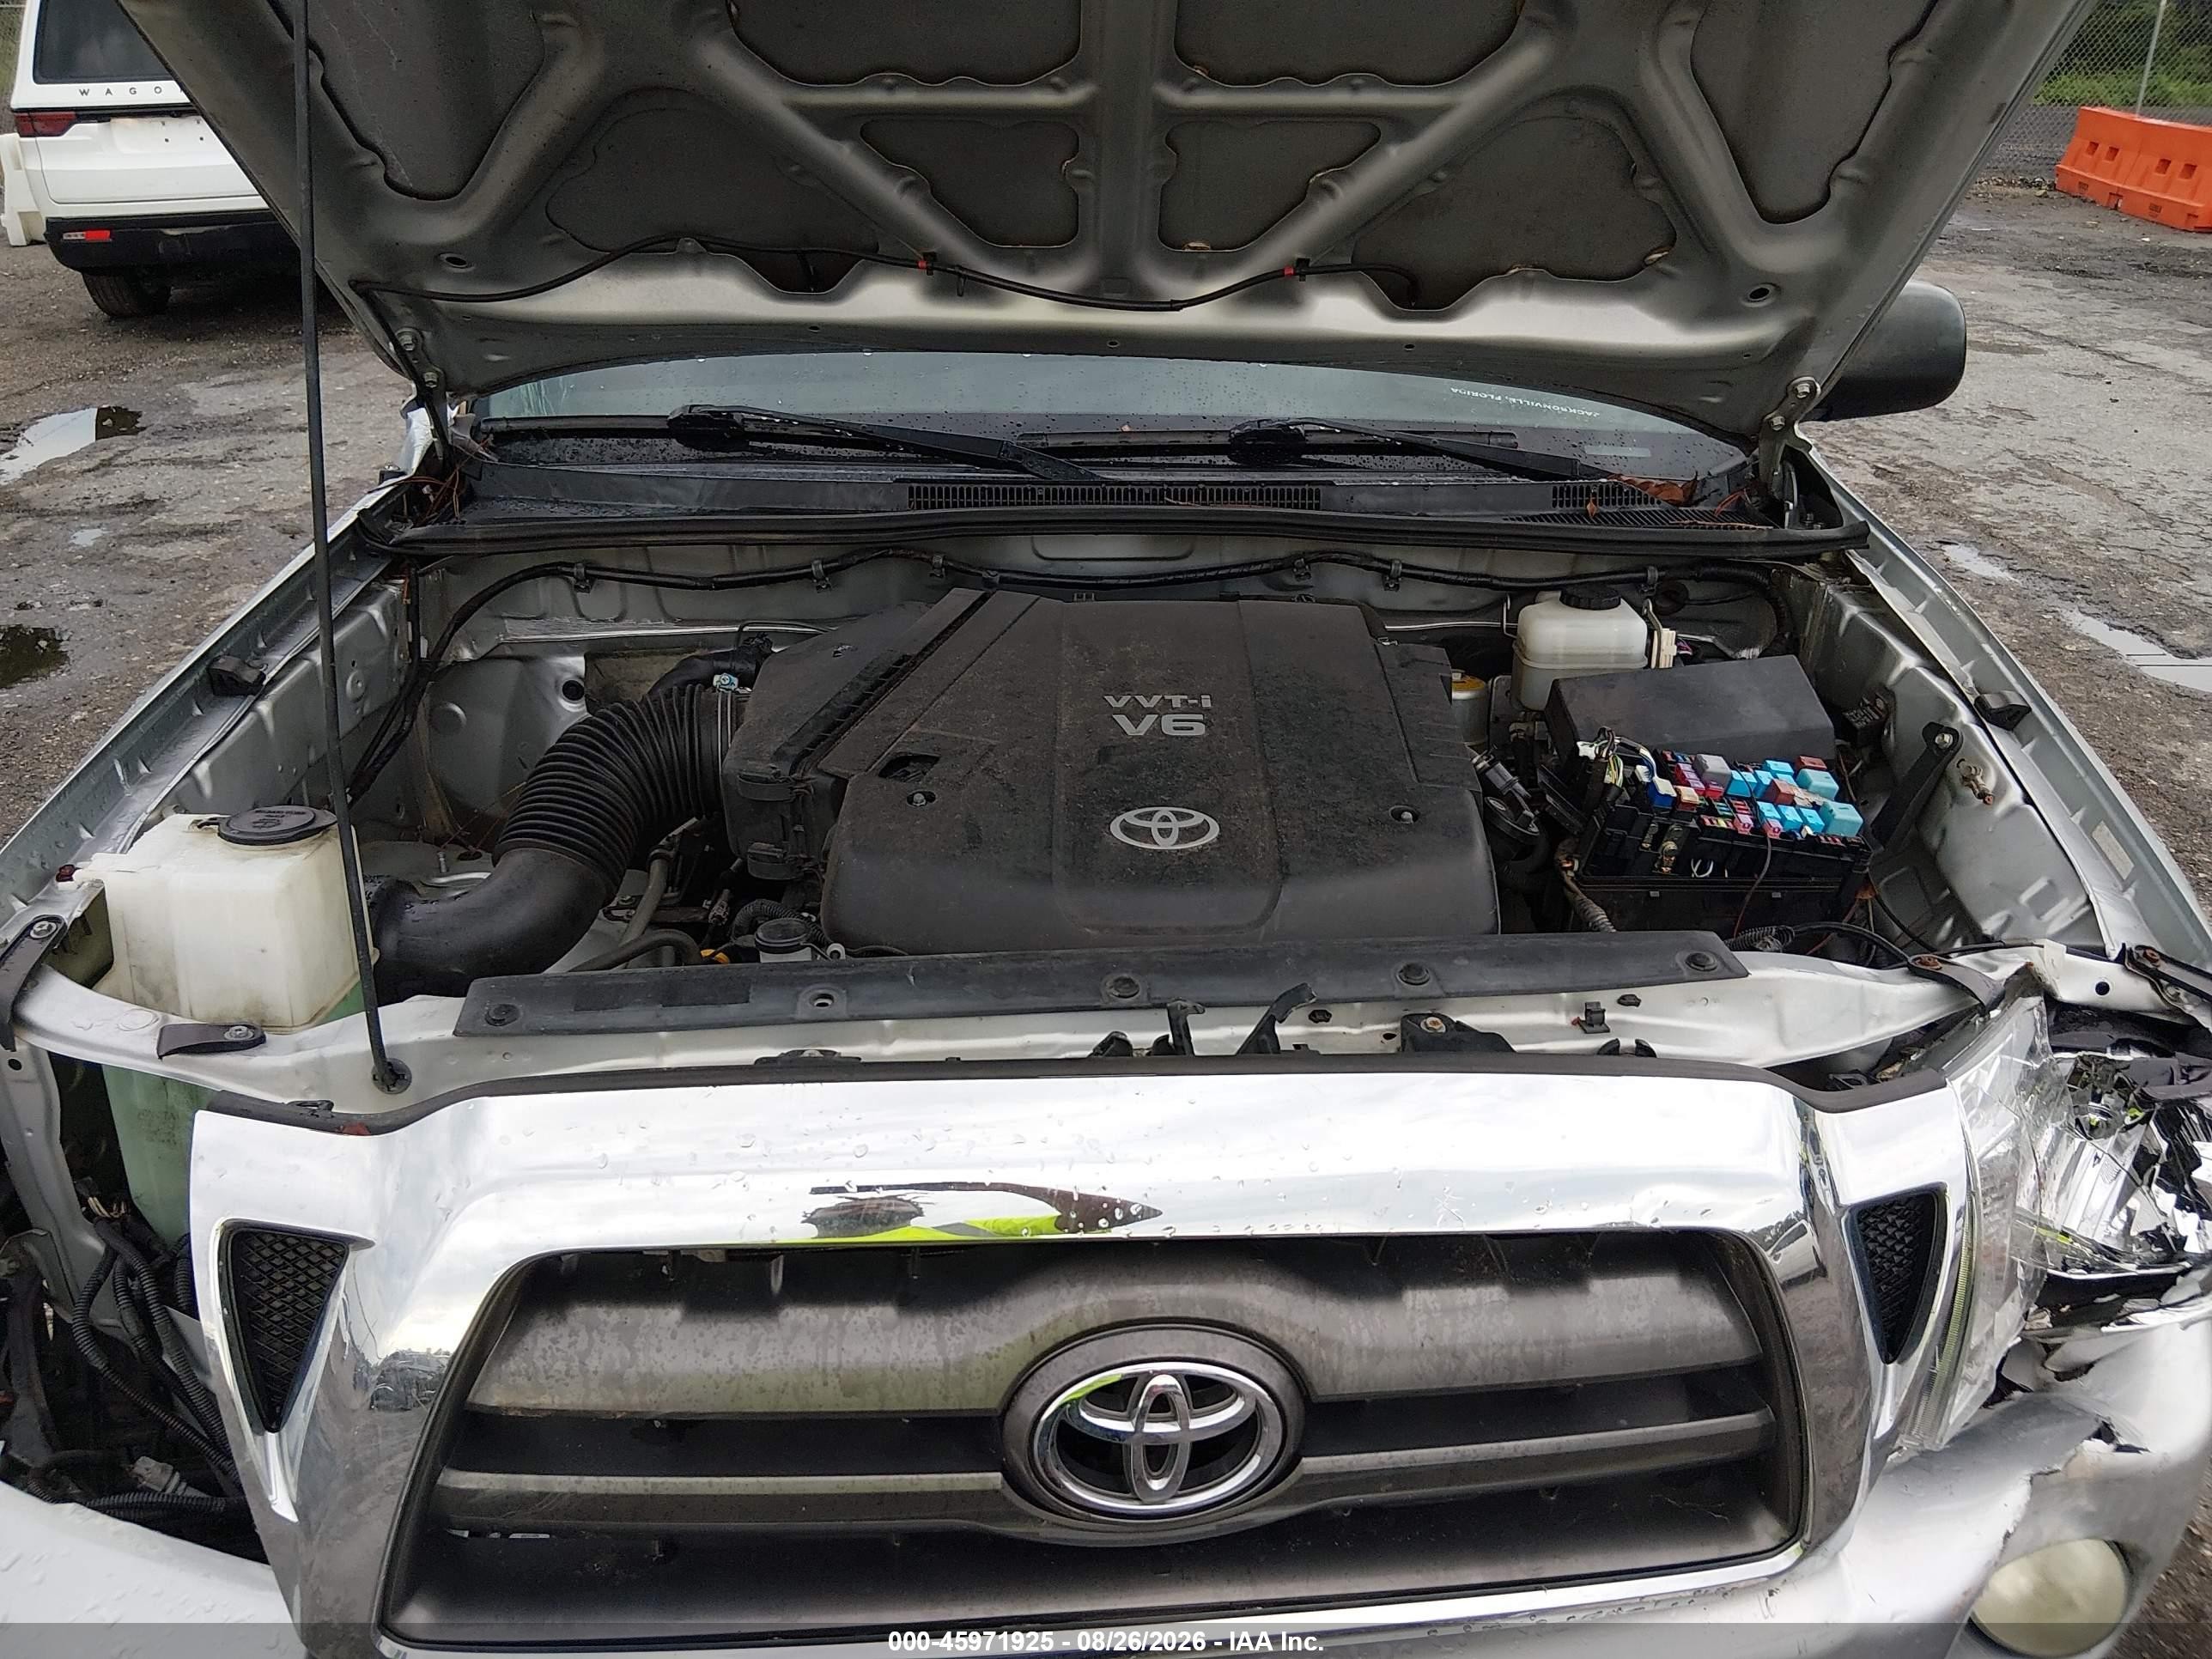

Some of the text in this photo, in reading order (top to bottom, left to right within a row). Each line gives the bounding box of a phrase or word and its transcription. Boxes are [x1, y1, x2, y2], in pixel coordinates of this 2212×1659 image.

[78, 85, 184, 97] WAGO
[1450, 386, 1503, 402] FLORIDA
[1111, 714, 1206, 736] V6
